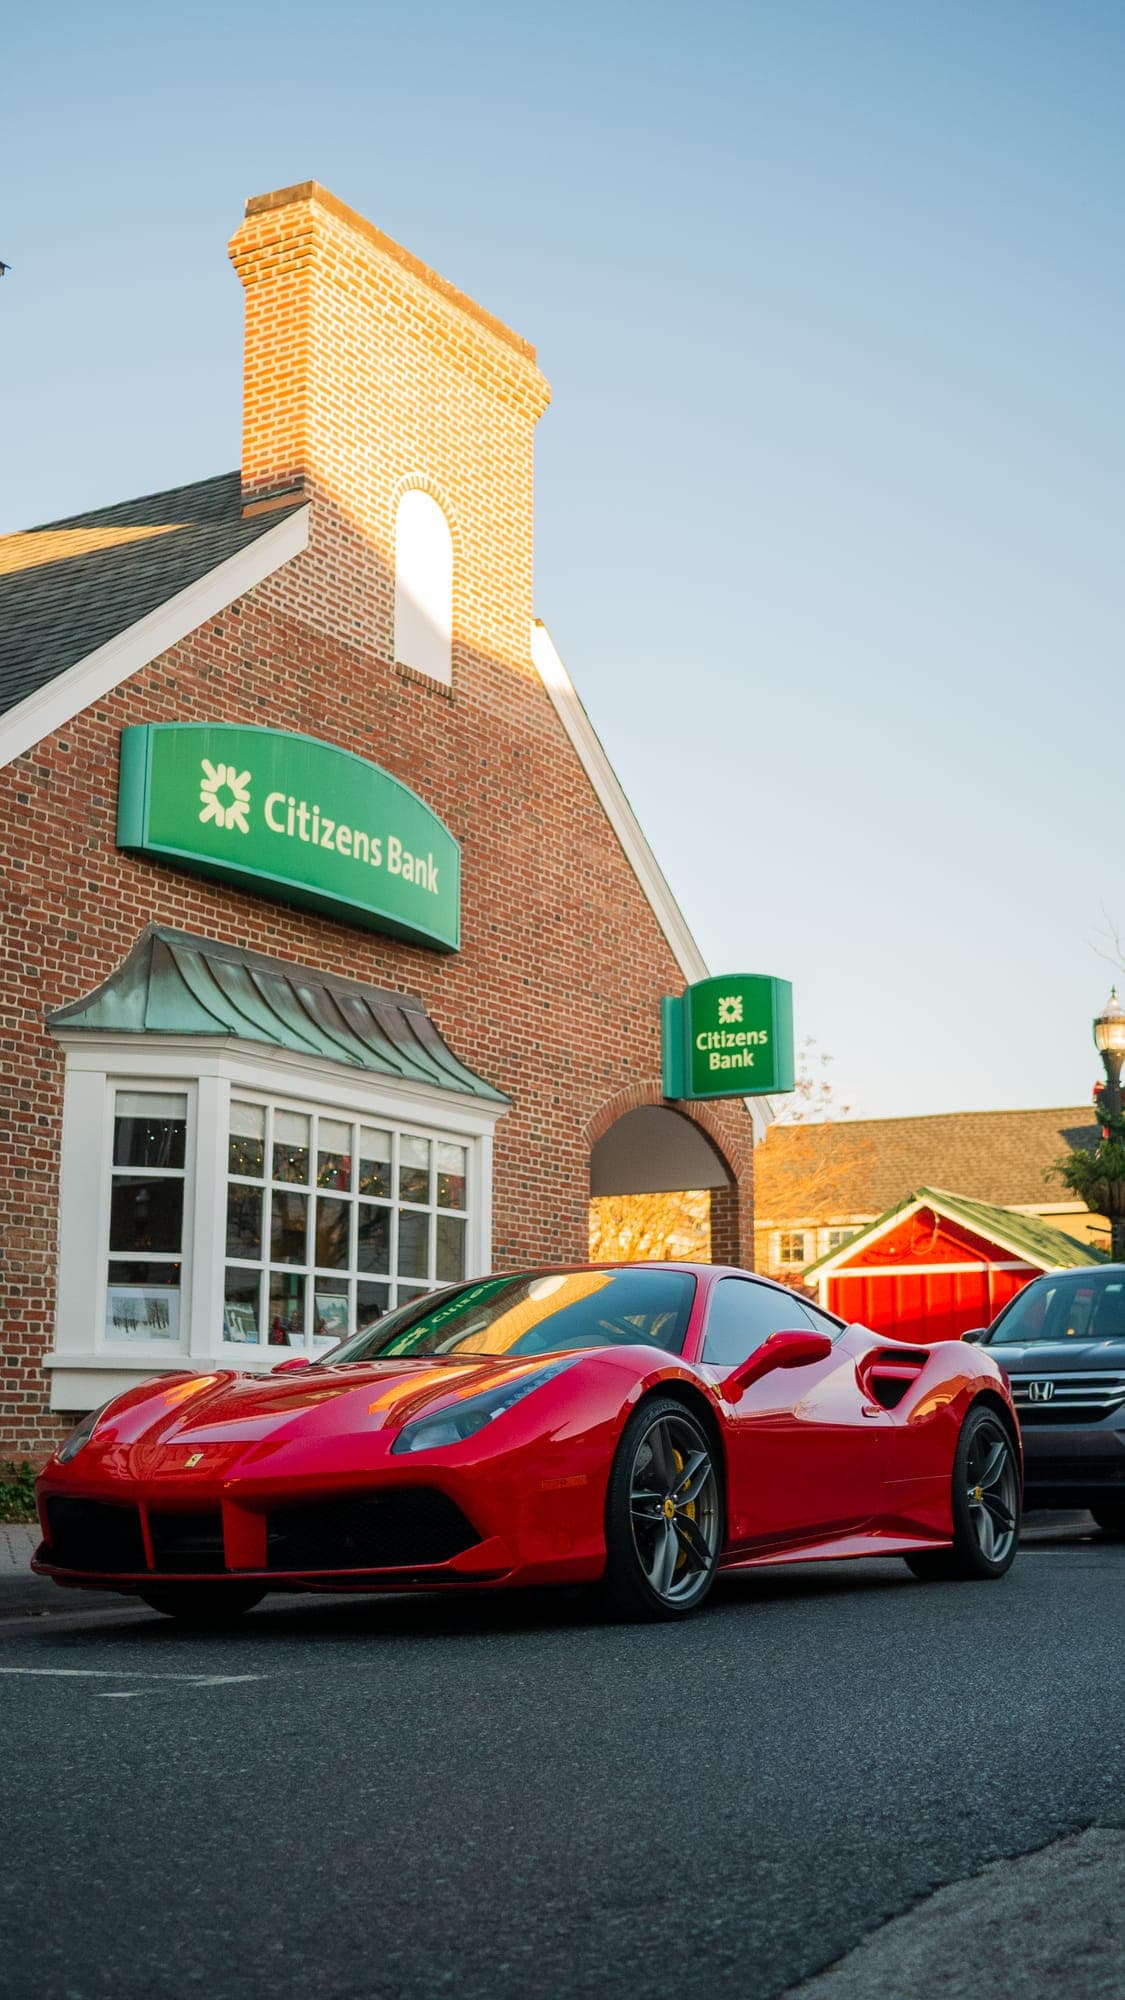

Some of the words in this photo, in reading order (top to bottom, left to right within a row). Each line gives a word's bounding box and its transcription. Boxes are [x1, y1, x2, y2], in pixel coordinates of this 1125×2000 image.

[264, 792, 382, 867] Citizens
[387, 835, 439, 895] Bank
[695, 1030, 768, 1050] Citizens
[709, 1048, 754, 1070] Bank
